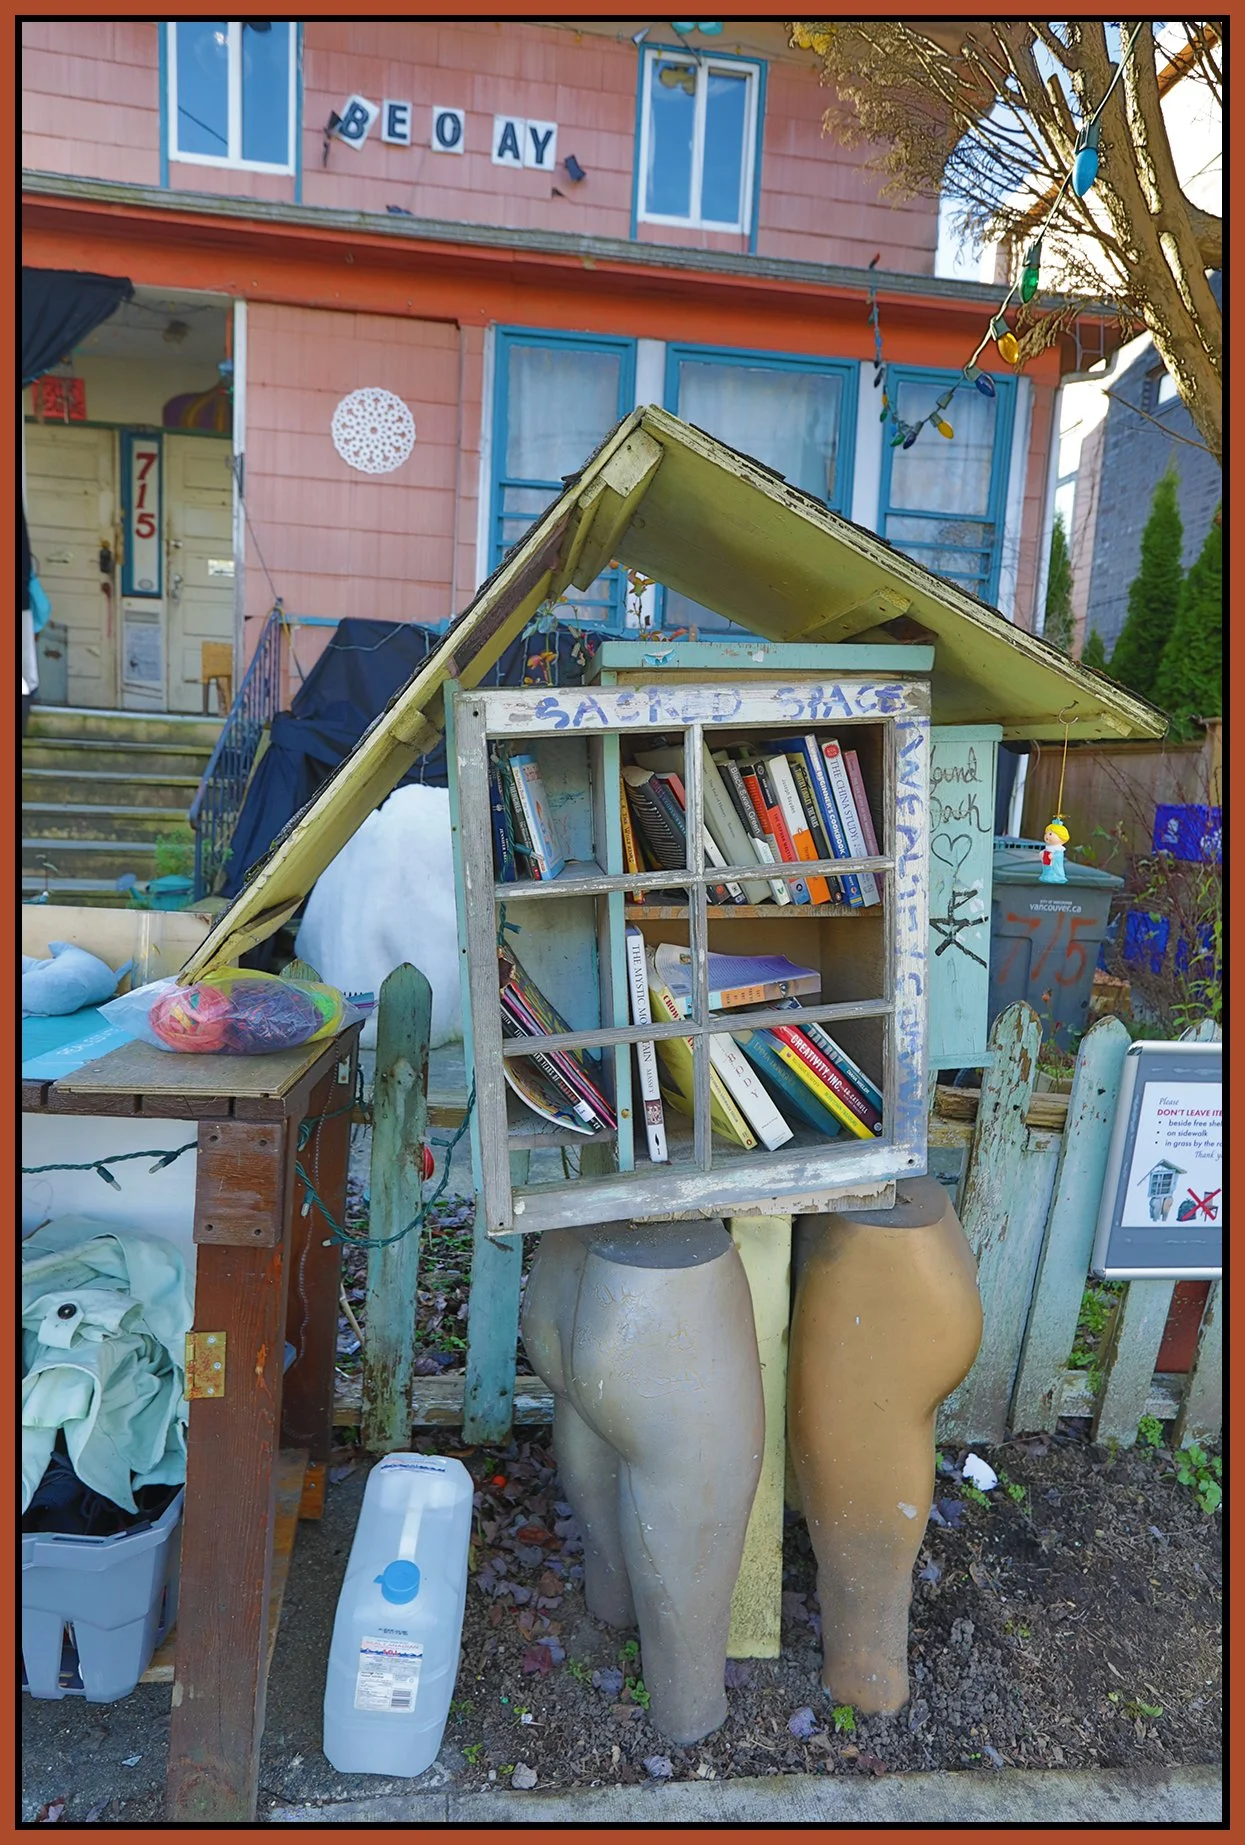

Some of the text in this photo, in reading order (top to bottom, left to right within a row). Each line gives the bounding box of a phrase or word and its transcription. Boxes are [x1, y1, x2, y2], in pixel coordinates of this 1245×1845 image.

[135, 452, 157, 539] 715
[776, 684, 908, 720] SPACE
[730, 767, 743, 789] Black
[739, 788, 752, 812] Swan
[748, 811, 761, 835] Green
[830, 760, 840, 778] THE
[835, 778, 850, 809] CHINA
[816, 770, 832, 813] BEGINNER'S
[829, 812, 846, 854] COOKBOOK
[1029, 903, 1082, 913] vancouver.ca
[632, 945, 642, 967] THE
[633, 967, 646, 1005] MYSTIC
[638, 1005, 652, 1062] MOTAIN
[806, 1027, 843, 1066] BAD BOY
[540, 1061, 554, 1076] YEARS
[790, 1034, 842, 1092] CREATIVITY, INC.
[1159, 1097, 1179, 1105] Please
[1169, 1119, 1192, 1127] beside
[1193, 1140, 1203, 1148] by
[1194, 1150, 1215, 1159] Thank
